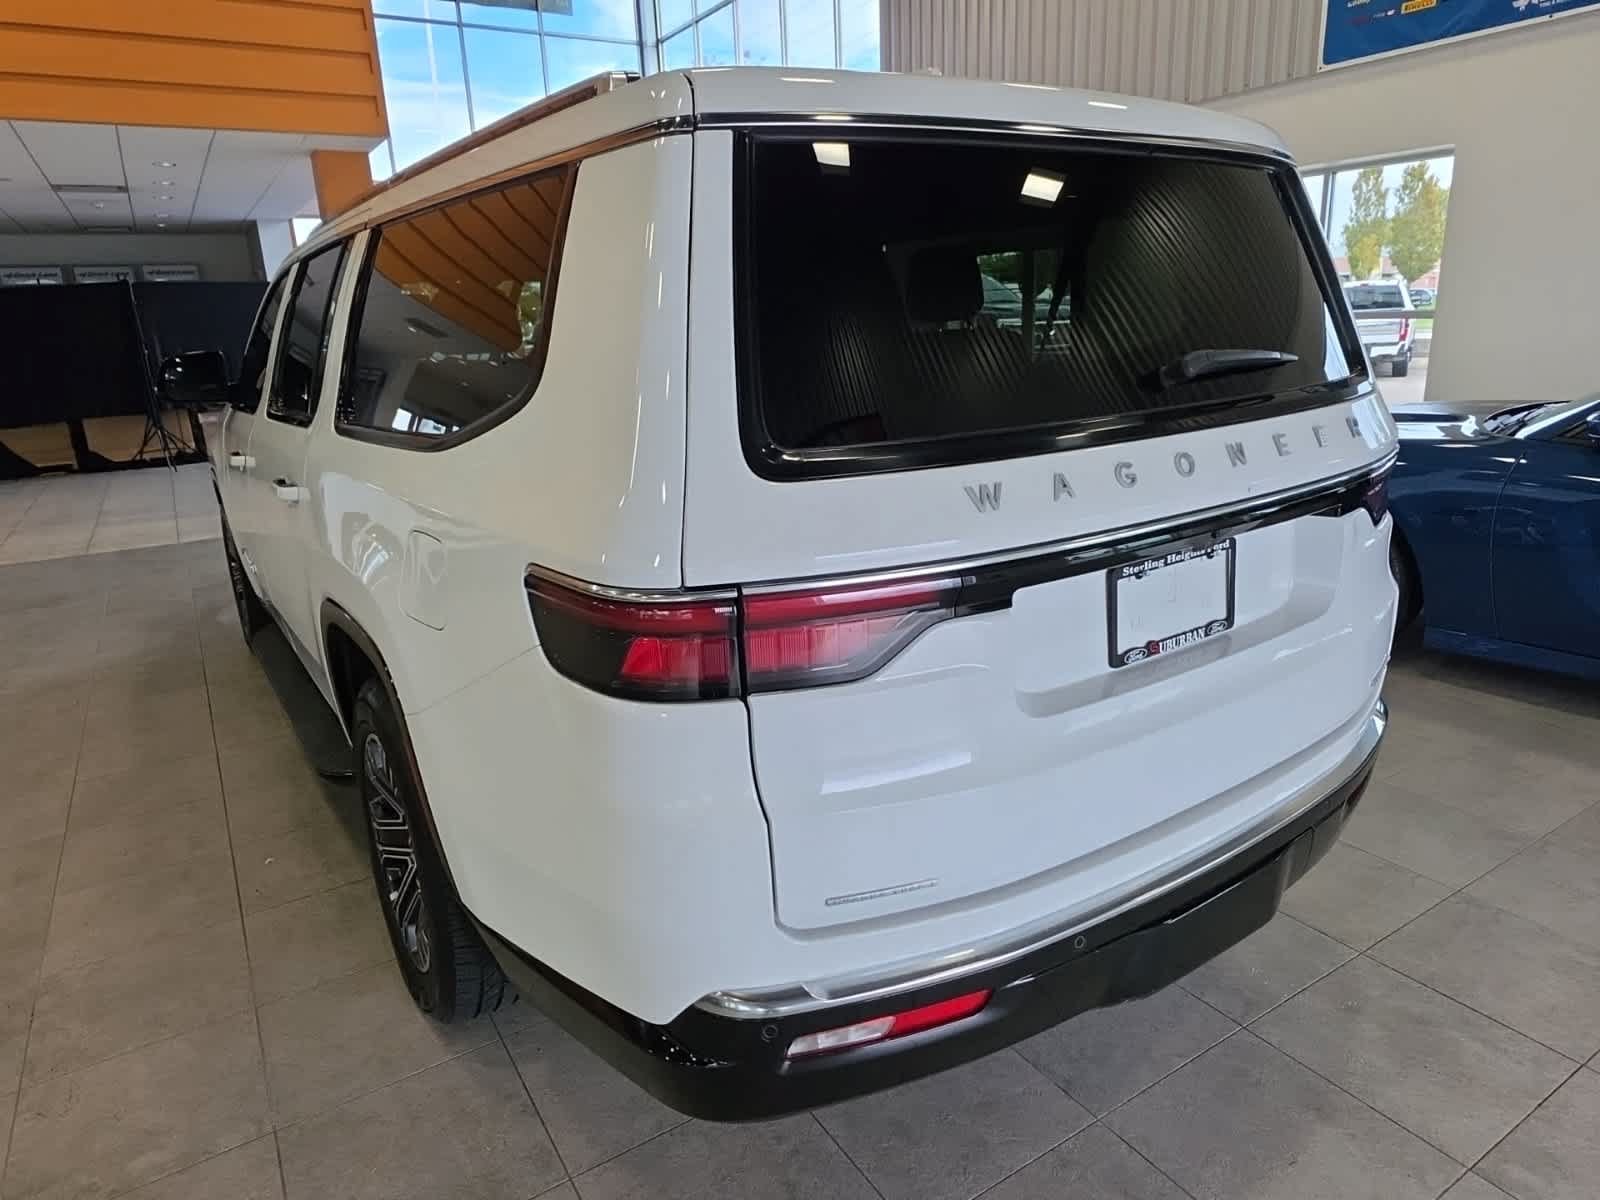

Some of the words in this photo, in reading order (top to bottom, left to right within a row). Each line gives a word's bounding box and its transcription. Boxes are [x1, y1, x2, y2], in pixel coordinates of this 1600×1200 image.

[964, 414, 1361, 513] WAGONEER
[1122, 559, 1165, 576] Sterling
[1150, 627, 1205, 654] SUBURBAN
